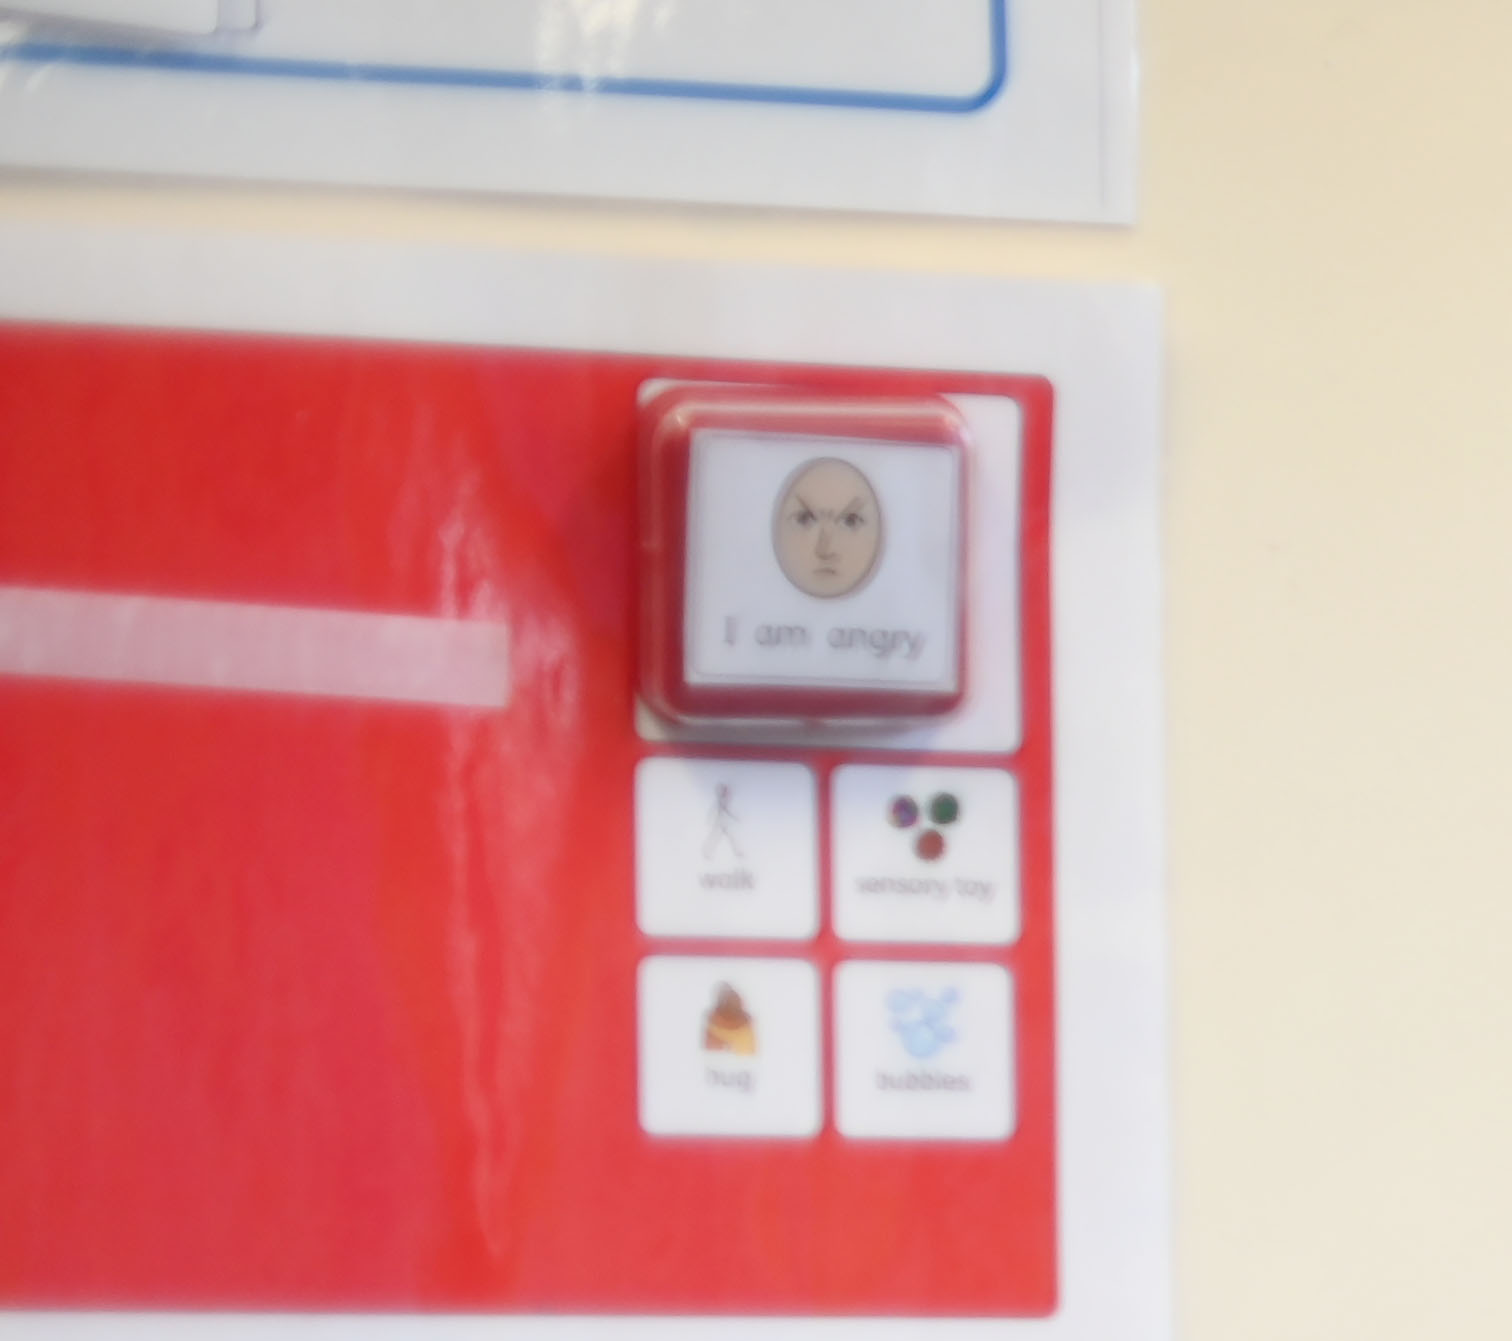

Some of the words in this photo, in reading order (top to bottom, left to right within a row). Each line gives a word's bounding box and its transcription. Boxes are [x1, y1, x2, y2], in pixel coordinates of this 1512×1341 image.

[723, 616, 738, 646] I
[754, 624, 810, 648] am
[826, 626, 927, 661] angry
